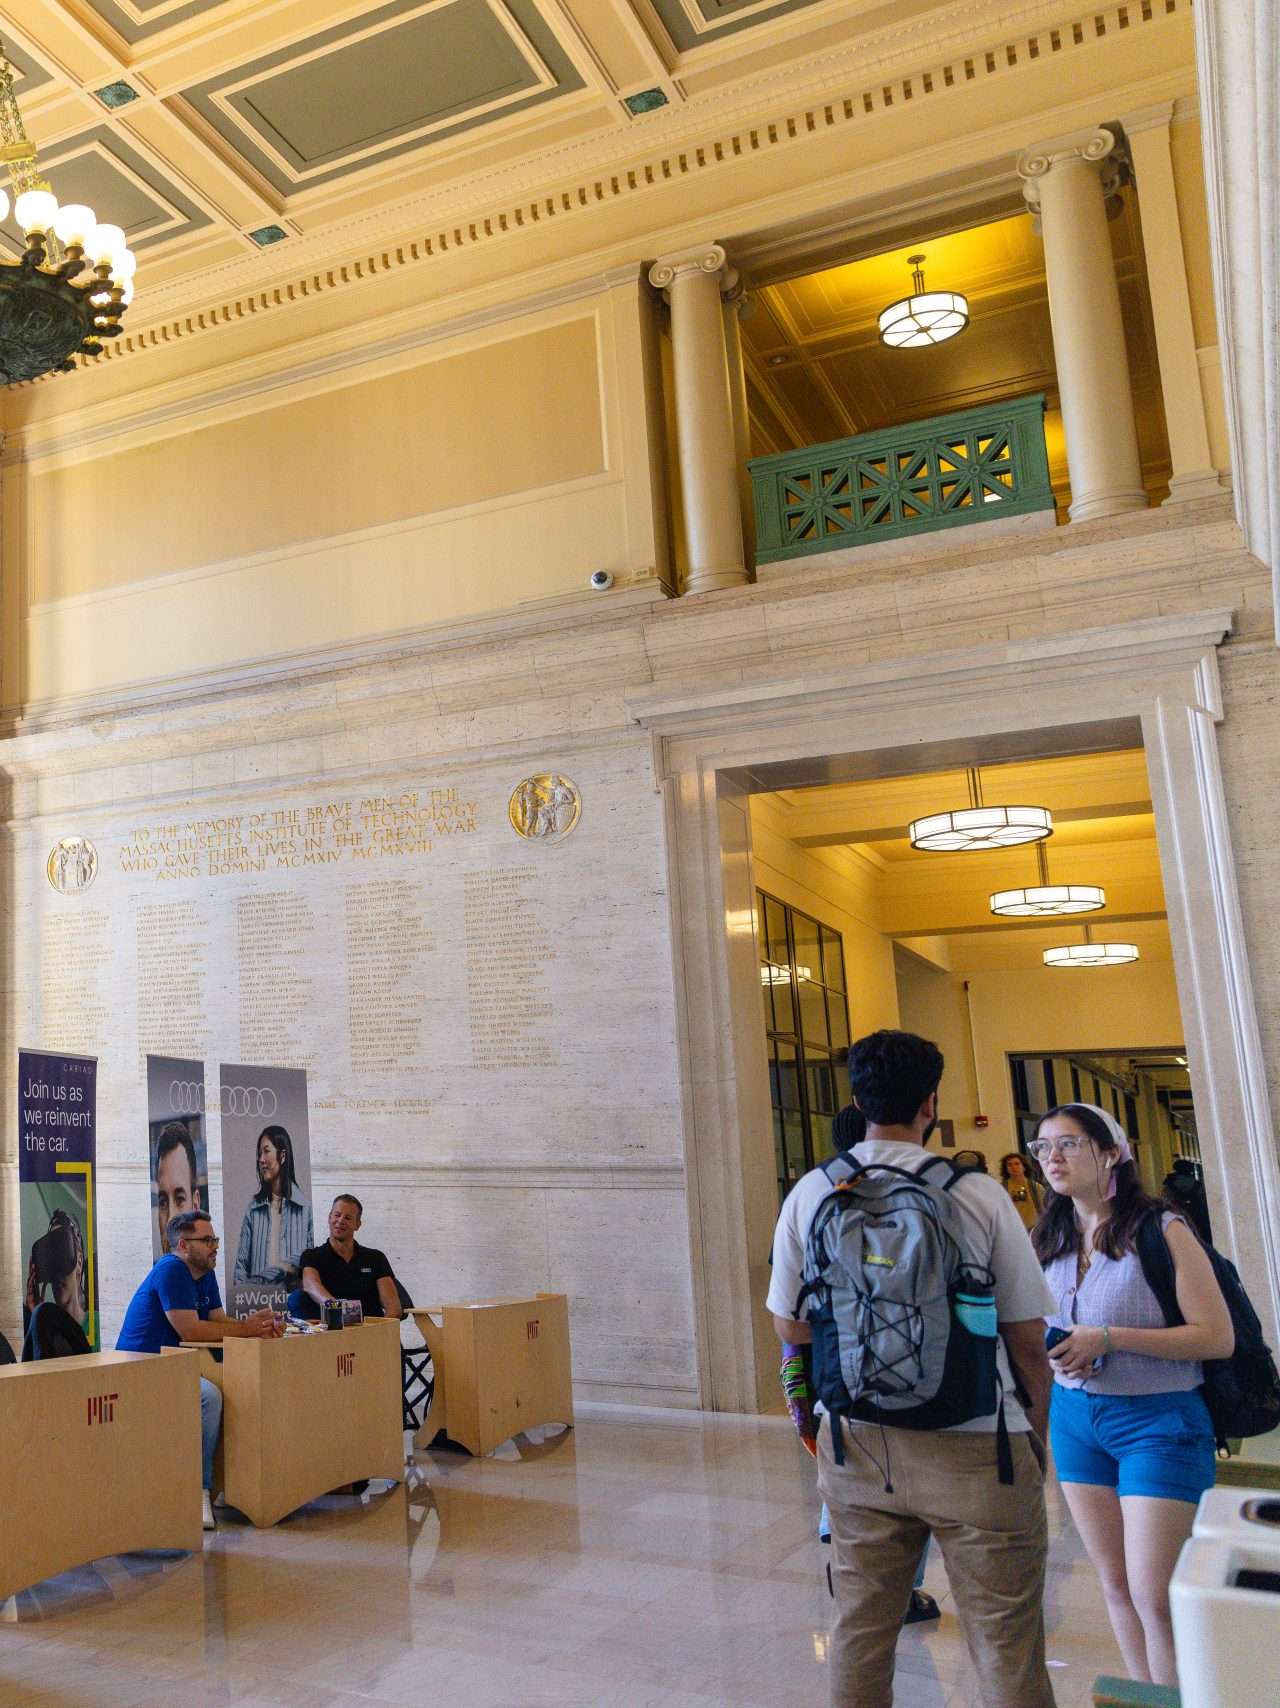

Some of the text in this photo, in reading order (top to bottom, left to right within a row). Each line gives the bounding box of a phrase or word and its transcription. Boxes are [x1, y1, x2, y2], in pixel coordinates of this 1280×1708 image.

[120, 802, 481, 858] MASSACHUSETTS INSTITUTE OF TECHNOLOGY
[132, 788, 459, 842] TO THE MEMORY OF THE BRAVE MEN OF THE
[121, 817, 479, 873] WHO GAVE THEIR LIVES IN THE GREAT WAR
[157, 866, 201, 881] ANNO
[208, 859, 267, 876] DOMINI
[277, 850, 342, 869] MCMXIV
[23, 1078, 83, 1102] Join us as
[23, 1106, 92, 1127] we reinvent
[24, 1130, 69, 1153] the car.
[337, 1352, 355, 1378] MIT
[87, 1393, 119, 1426] MIT
